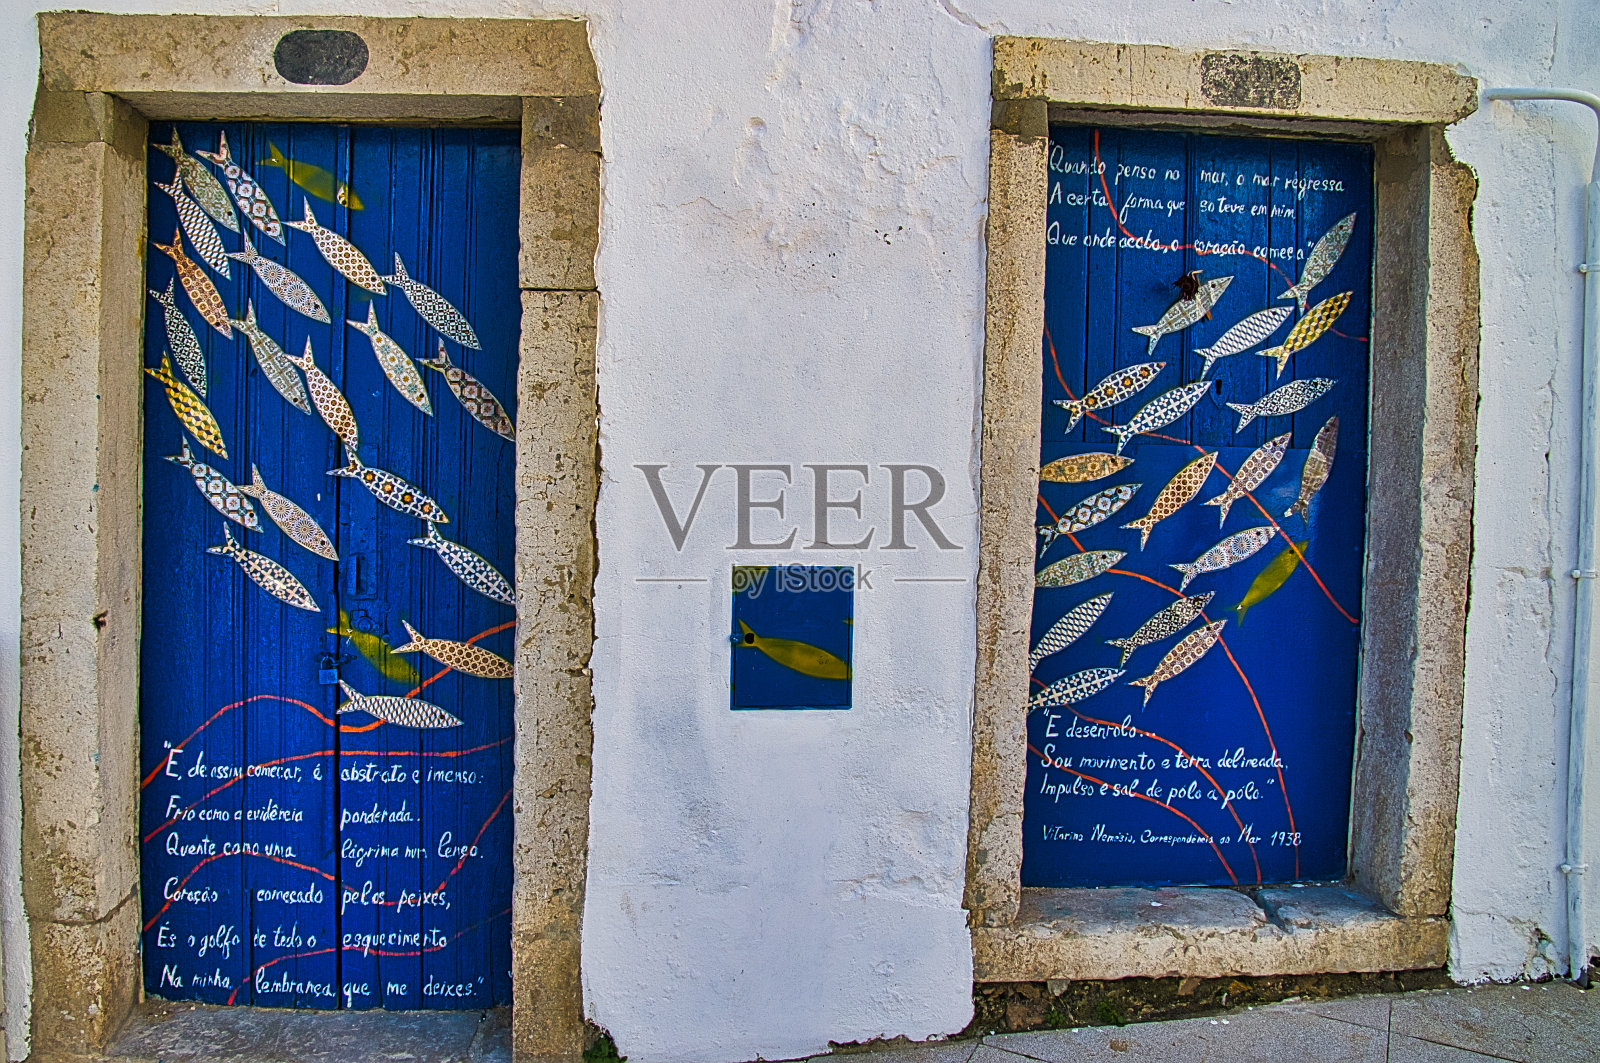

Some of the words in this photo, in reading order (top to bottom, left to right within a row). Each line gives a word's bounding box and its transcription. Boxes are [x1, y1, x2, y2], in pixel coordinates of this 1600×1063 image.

[1115, 163, 1156, 185] penso
[1165, 169, 1180, 180] no
[1237, 175, 1244, 185] o
[1253, 174, 1280, 186] mar
[1049, 182, 1062, 204] A
[1067, 189, 1109, 206] certa
[1119, 192, 1164, 224] forma
[1167, 201, 1185, 217] que
[1217, 196, 1245, 213] teve
[1251, 205, 1267, 216] em
[1047, 221, 1077, 245] Que
[1084, 227, 1115, 248] onde
[1171, 240, 1178, 251] o
[1195, 239, 1245, 257] coração
[188, 751, 206, 777] de
[313, 764, 323, 780] é
[341, 761, 406, 783] abstrato
[412, 770, 419, 784] e
[1041, 743, 1072, 768] Sou
[1080, 752, 1155, 770] movimento
[1162, 759, 1170, 769] e
[1175, 749, 1211, 768] terra
[1040, 773, 1094, 804] Impulso
[1100, 783, 1108, 795] e
[1113, 779, 1139, 797] sal
[1146, 779, 1162, 798] de
[1207, 789, 1218, 800] a
[166, 795, 195, 821] Frio
[199, 810, 229, 821] como
[234, 811, 242, 820] a
[247, 799, 303, 821] evidência
[340, 800, 420, 831] ponderada.
[166, 832, 215, 856] Quente
[265, 843, 296, 857] uma
[341, 838, 399, 867] lágrima
[1238, 823, 1261, 844] Mar
[1271, 831, 1302, 846] 1938
[164, 876, 218, 904] Coração
[341, 880, 385, 915] pelos
[157, 921, 176, 947] És
[188, 935, 195, 947] o
[198, 924, 240, 960] golfo
[254, 925, 266, 947] de
[307, 935, 316, 947] o
[343, 926, 447, 958] esquecimento
[160, 964, 183, 987] Na
[192, 968, 232, 989] minha
[343, 981, 370, 1008] que
[387, 981, 407, 995] me
